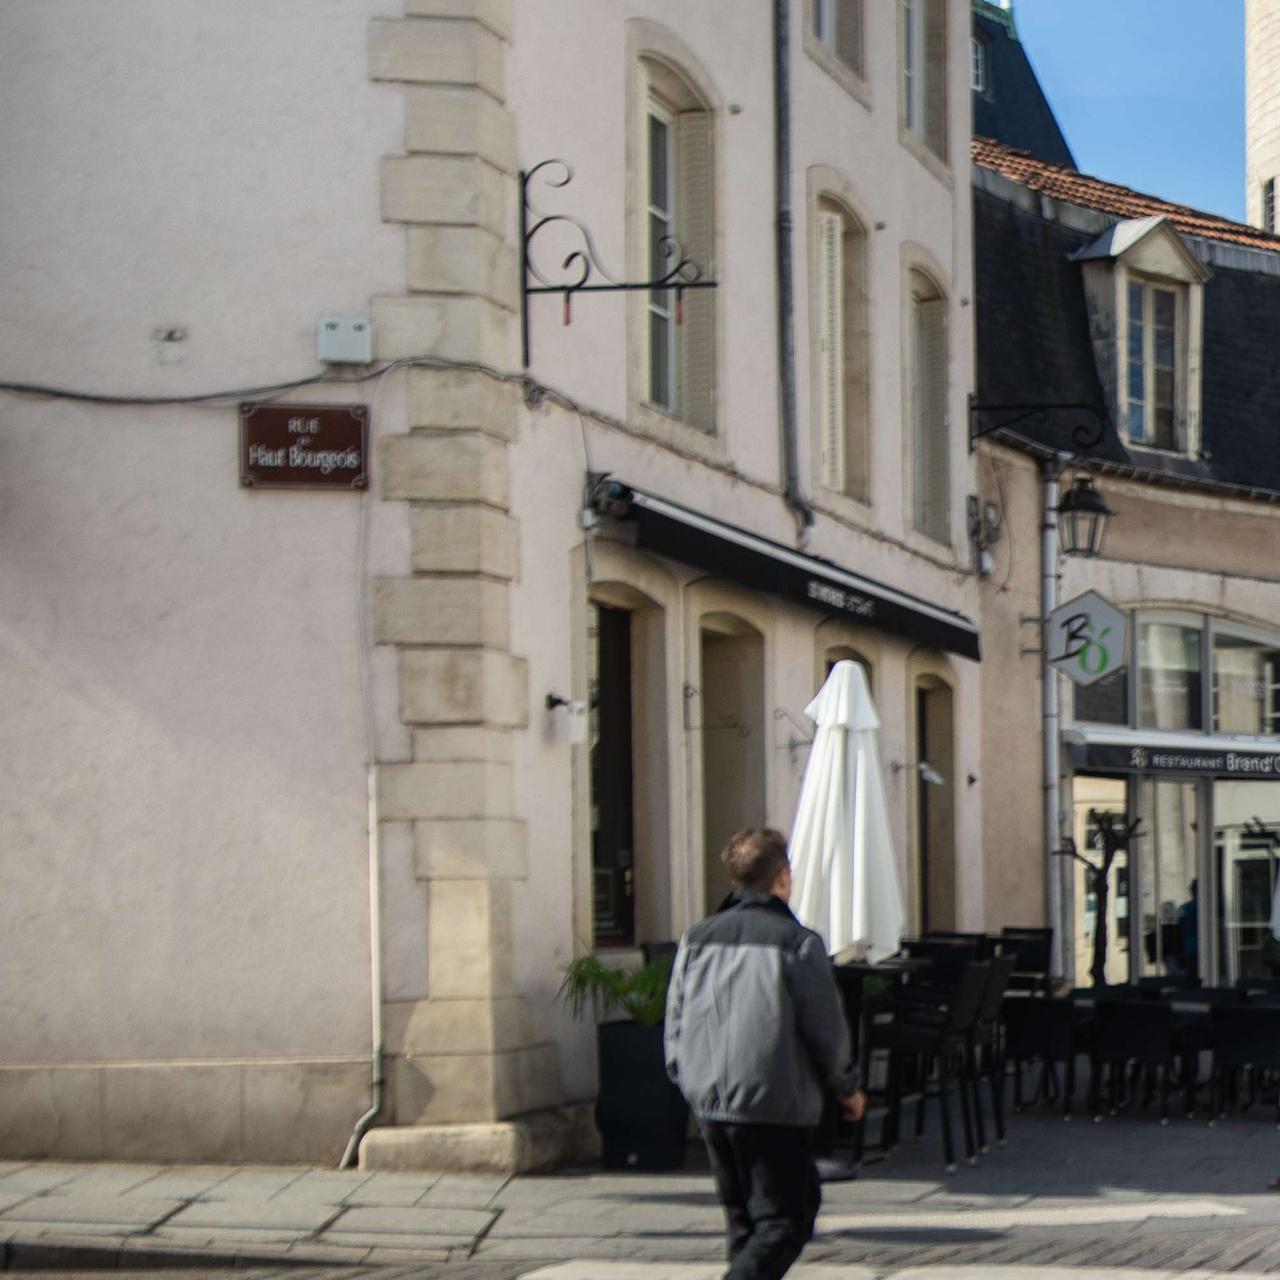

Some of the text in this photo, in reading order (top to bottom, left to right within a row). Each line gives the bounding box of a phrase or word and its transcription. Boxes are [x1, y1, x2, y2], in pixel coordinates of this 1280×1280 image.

[287, 417, 320, 434] RUE
[249, 445, 360, 474] Haut Bourgeois
[1152, 753, 1224, 769] RESTAURANT
